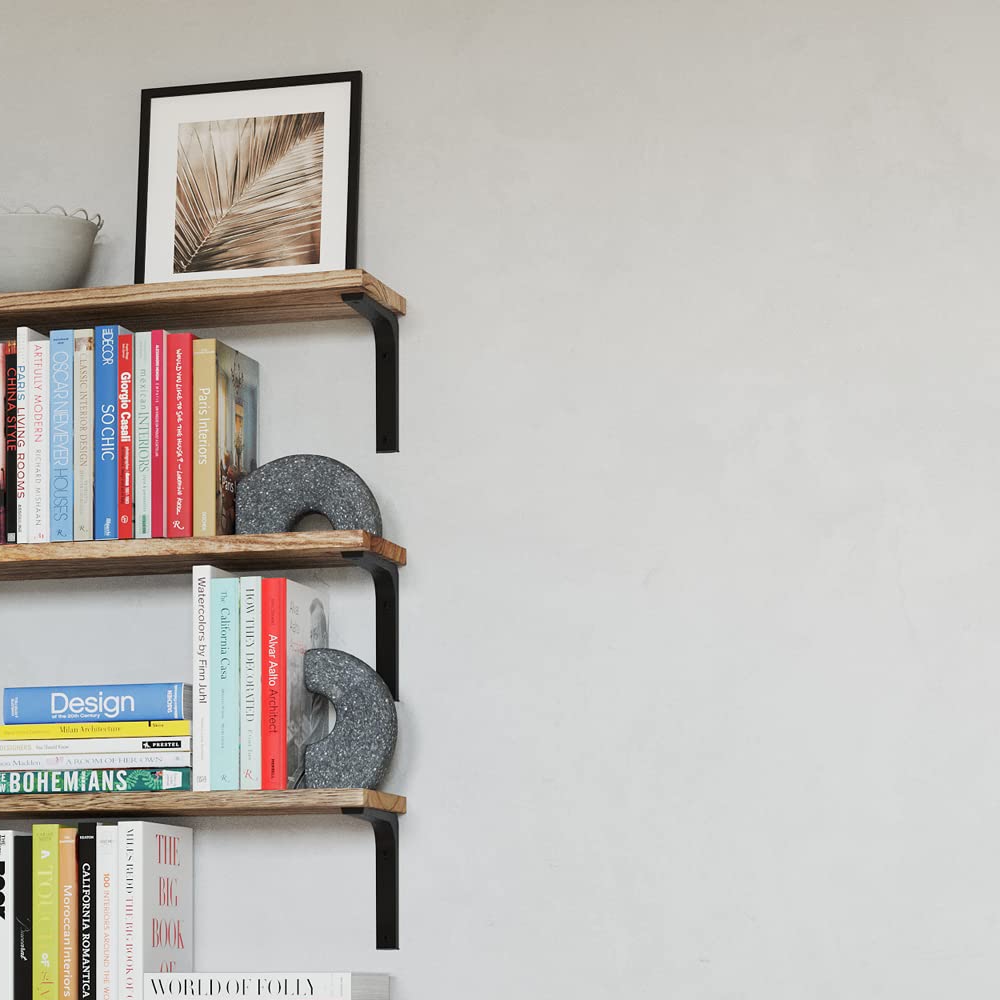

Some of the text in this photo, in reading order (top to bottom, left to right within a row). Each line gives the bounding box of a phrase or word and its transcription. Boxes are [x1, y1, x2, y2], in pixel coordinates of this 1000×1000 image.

[102, 333, 114, 366] DECOR
[175, 348, 184, 371] WOULD
[52, 351, 69, 398] OSCAR
[118, 371, 131, 410] Giorgio
[139, 368, 148, 410] mexican
[33, 345, 43, 443] ARTFULLY MODERN
[175, 384, 184, 401] LIKE
[7, 367, 17, 452] CHINA STYLE
[79, 390, 88, 432] INTERIOR
[198, 387, 211, 465] Paris Interiors
[17, 365, 25, 499] PARIS LIVING ROOMS
[52, 400, 69, 466] NIEMEYER
[101, 404, 115, 462] SO CHIC
[119, 411, 131, 442] Casali
[138, 411, 150, 473] INTERIORS
[175, 424, 184, 437] THE
[79, 434, 88, 467] DESIGN
[34, 449, 42, 526] RICHARD MISHAAN
[52, 468, 69, 521] HOUSES
[245, 588, 255, 614] HOW
[197, 577, 207, 704] Watercolors by Finn Juhl
[220, 607, 231, 655] California
[245, 618, 255, 648] THEY
[268, 633, 279, 658] Alvar
[220, 657, 231, 680] Casa
[268, 660, 279, 686] Aalto
[245, 652, 255, 722] DECORATED
[51, 691, 134, 717] Design
[268, 688, 279, 734] Architect
[59, 725, 78, 734] Milan
[10, 769, 127, 792] BOHEMIANS
[41, 850, 51, 859] A
[126, 828, 134, 861] MILES
[155, 833, 180, 867] THE
[103, 873, 111, 889] 100
[126, 864, 134, 894] REDD
[159, 876, 178, 907] BIG
[103, 890, 111, 930] INTERIORS
[126, 896, 134, 918] THE
[62, 885, 73, 998] Moroccan Interiors
[81, 863, 91, 998] CALIFORNIA ROMANTICA
[126, 922, 134, 941] BIG
[152, 918, 185, 949] BOOK
[103, 932, 111, 966] AROUND
[126, 944, 134, 974] BOOK
[103, 969, 111, 984] THE
[126, 977, 134, 991] OF
[151, 978, 314, 996] WORLD OF FOLLY
